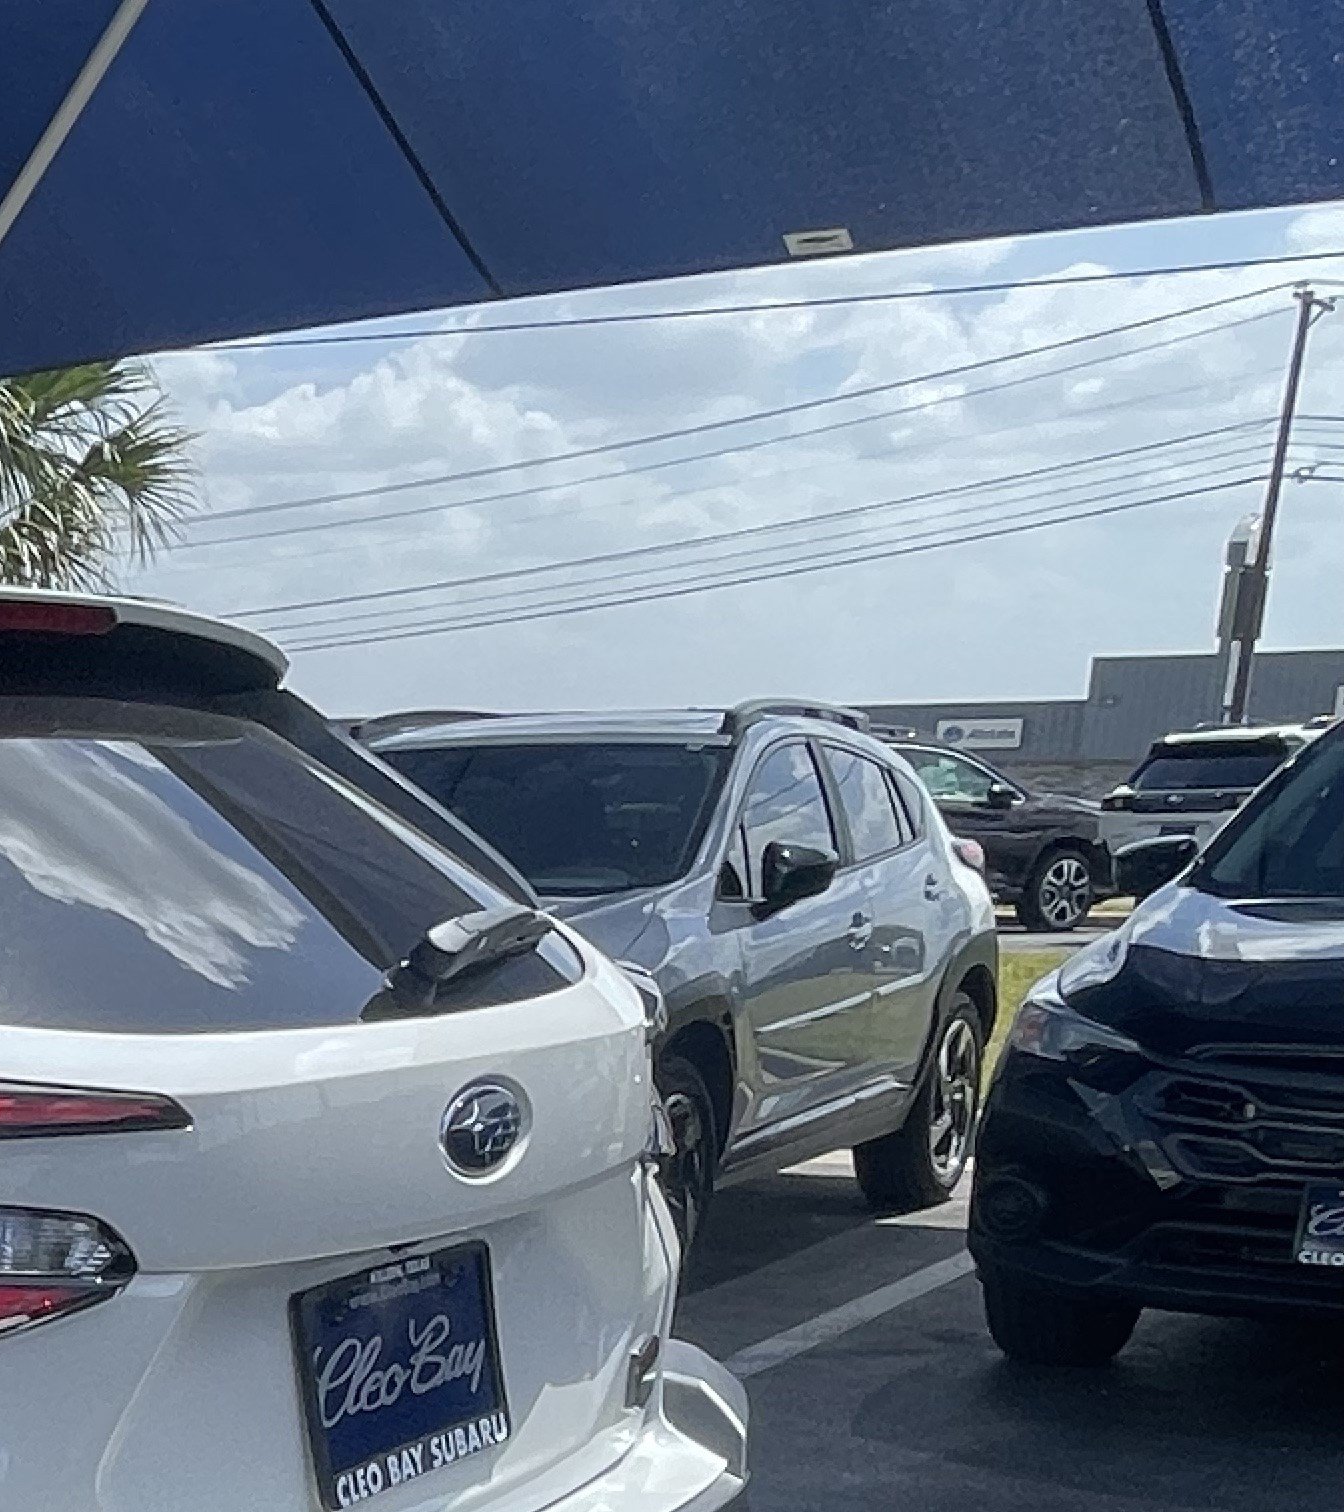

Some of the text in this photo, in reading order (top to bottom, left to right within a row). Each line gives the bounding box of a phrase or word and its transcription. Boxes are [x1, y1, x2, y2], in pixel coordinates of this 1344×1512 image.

[313, 1315, 486, 1428] Cleo Bay
[336, 1411, 509, 1507] CLEO BAY SUBARU
